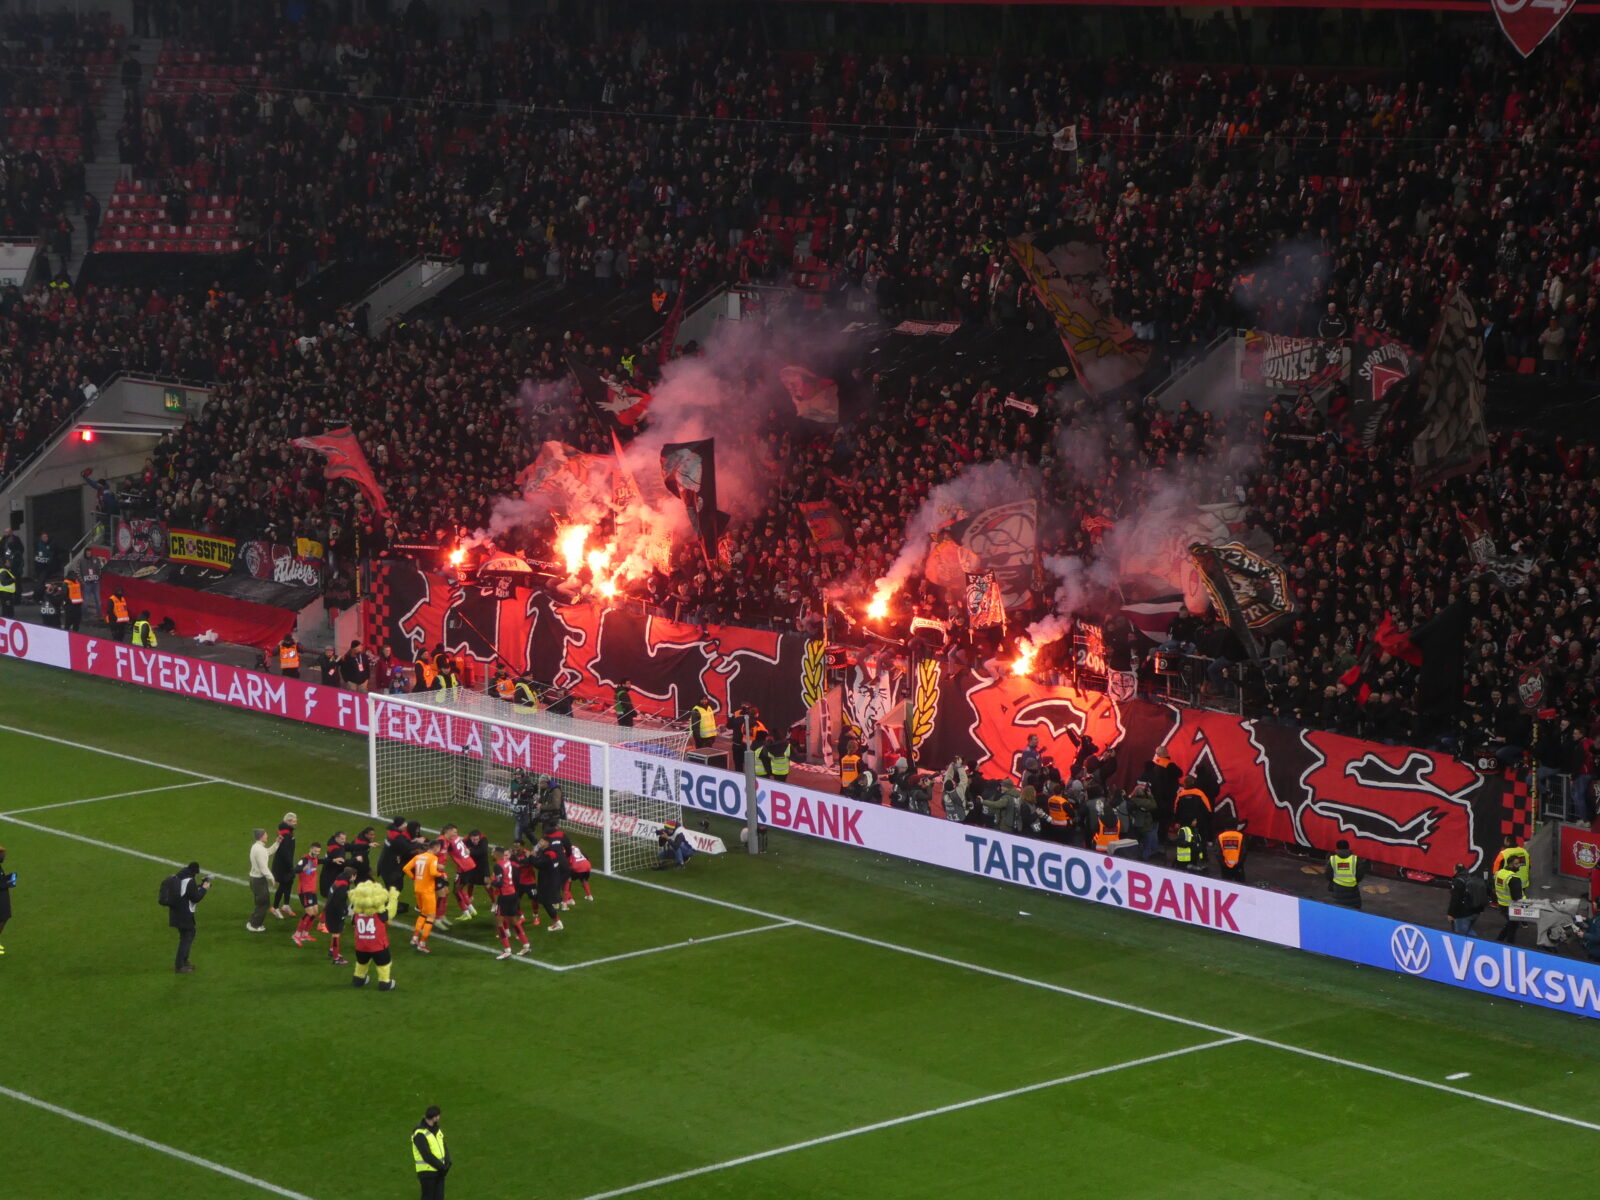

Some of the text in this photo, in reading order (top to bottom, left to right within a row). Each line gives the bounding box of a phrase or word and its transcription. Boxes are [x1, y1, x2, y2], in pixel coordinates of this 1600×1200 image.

[116, 646, 287, 714] FLYERALARM
[338, 692, 531, 768] FLYERALARM
[635, 760, 865, 845] TARGO BANK
[965, 834, 1240, 932] TARGO BANK
[357, 918, 376, 934] 04
[1442, 935, 1600, 1011] Volksw
